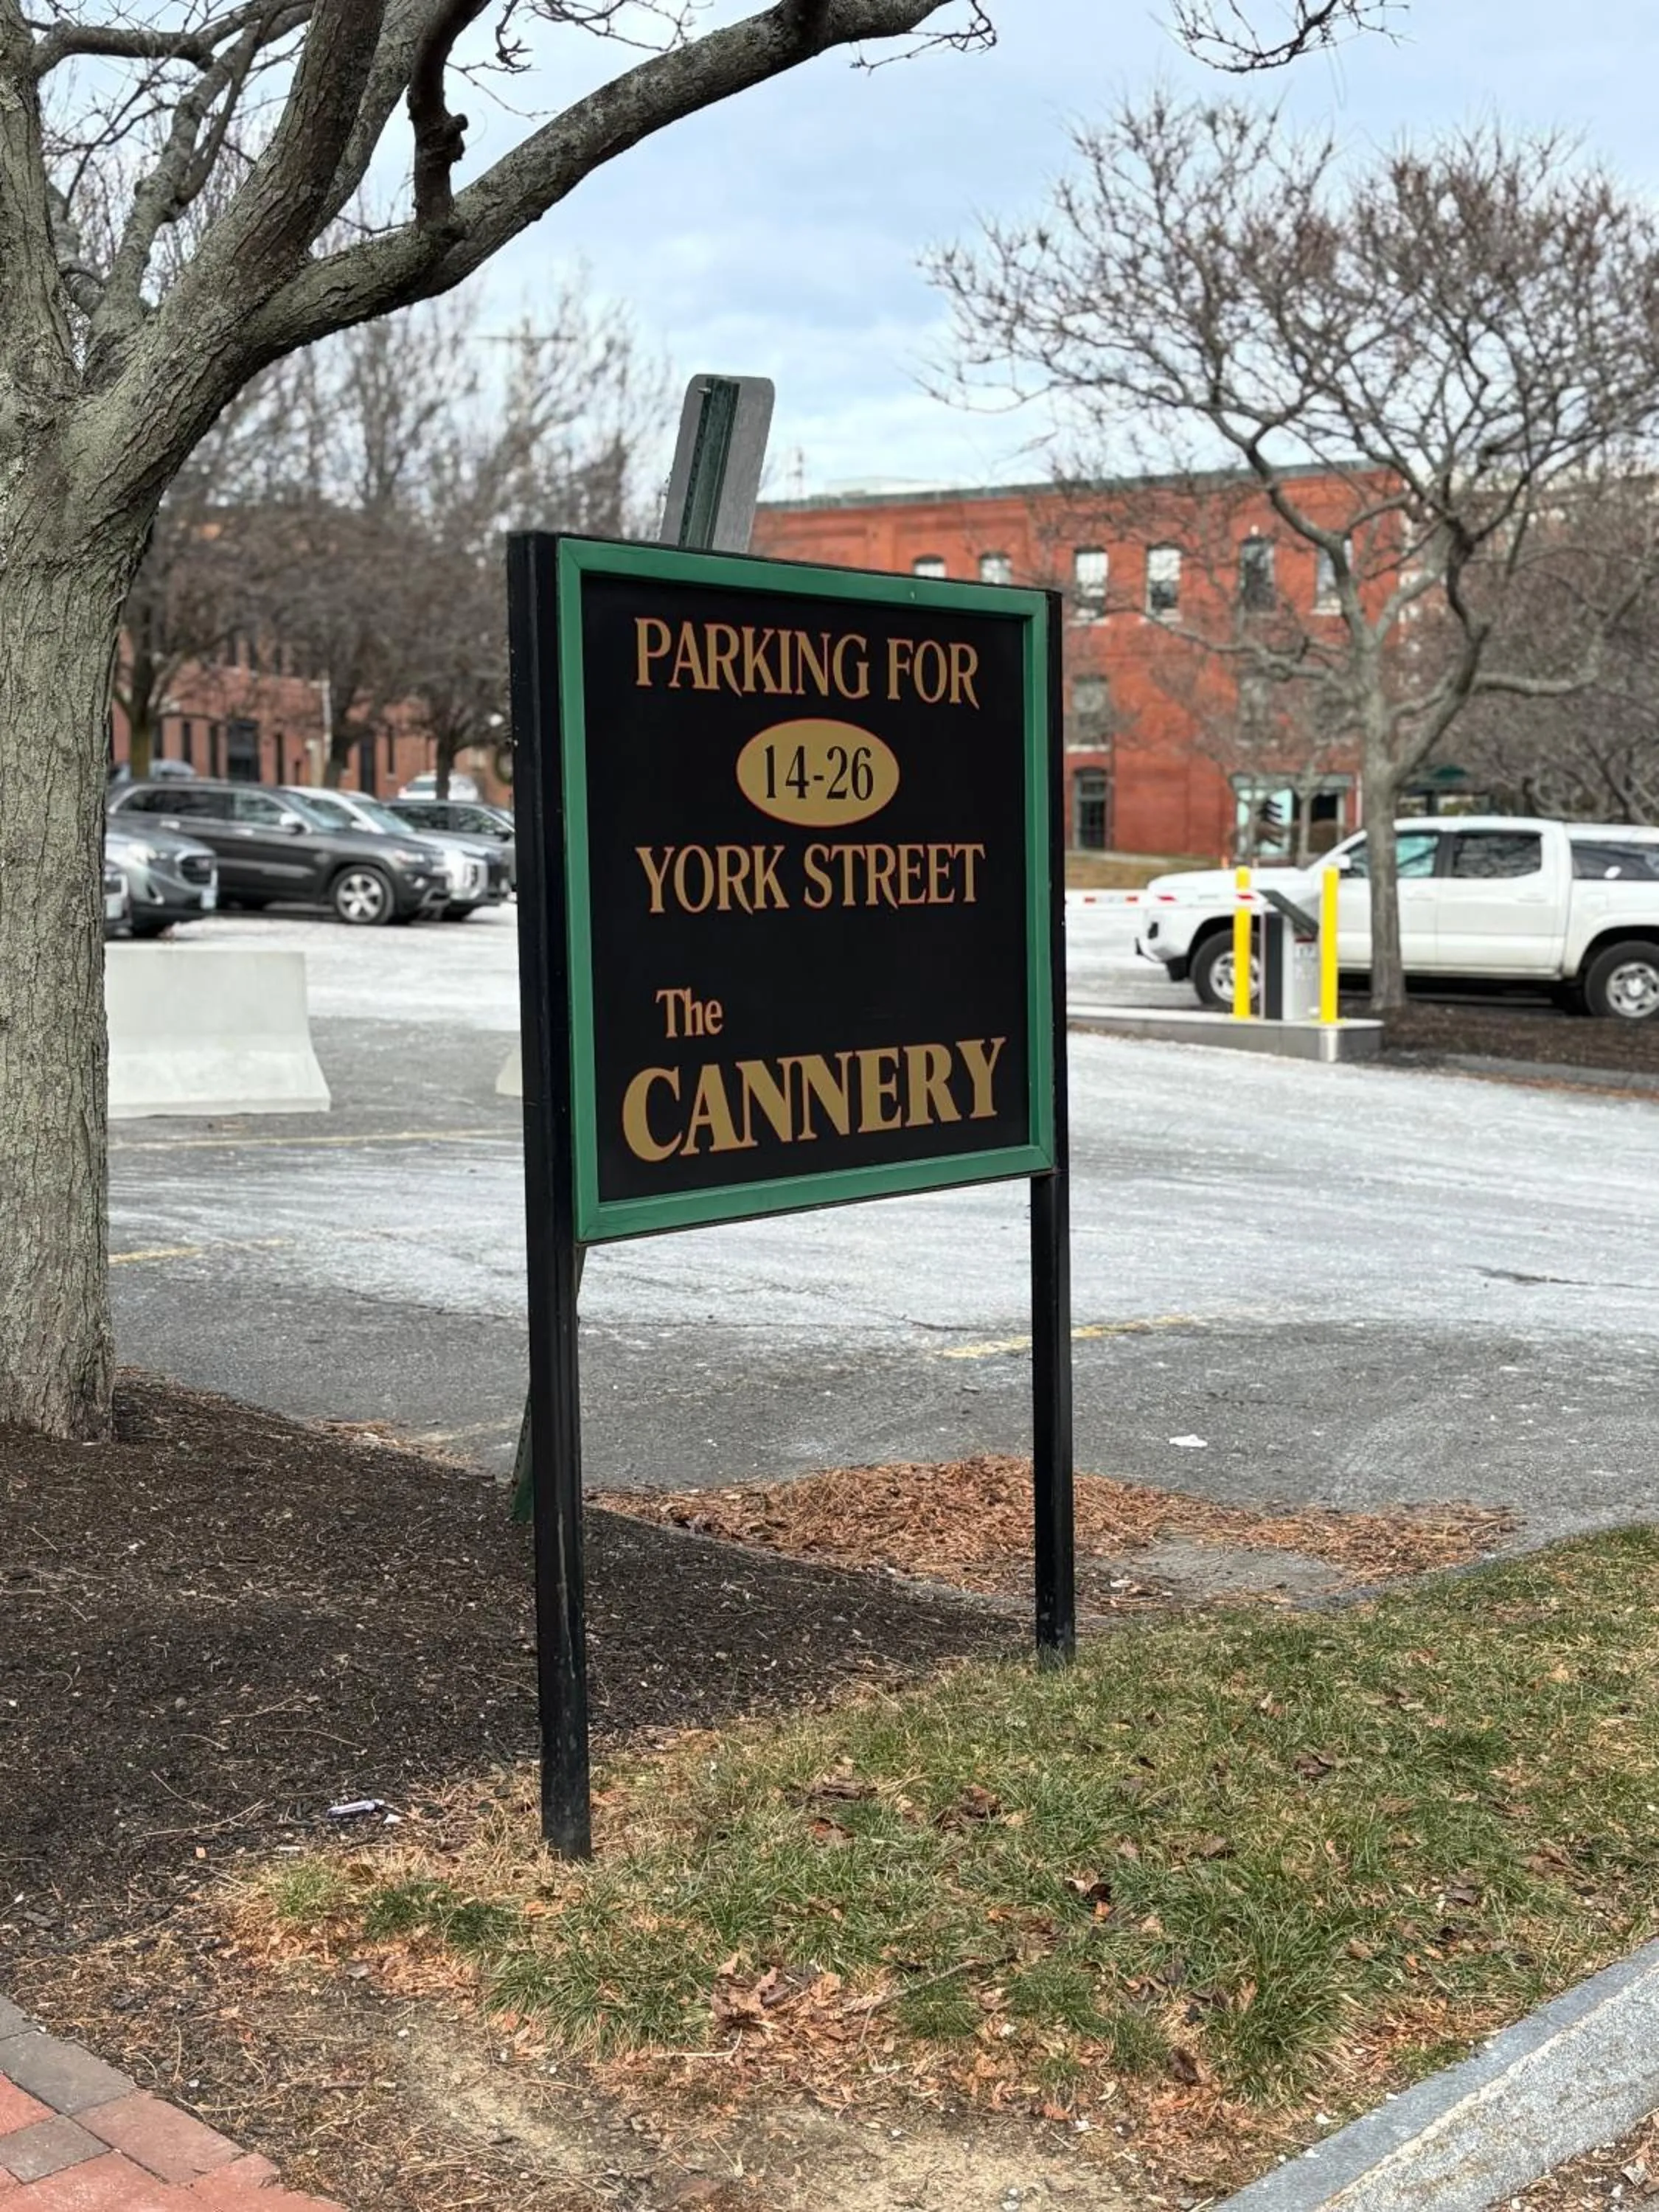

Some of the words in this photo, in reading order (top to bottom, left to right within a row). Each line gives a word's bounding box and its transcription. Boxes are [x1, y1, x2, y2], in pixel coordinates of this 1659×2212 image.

[635, 617, 869, 698] PARKING
[887, 638, 980, 709] FOR
[763, 744, 875, 802] 14-26
[635, 845, 788, 914] YORK
[804, 843, 985, 909] STREET
[655, 987, 723, 1039] The
[622, 1036, 1007, 1163] CANNERY
